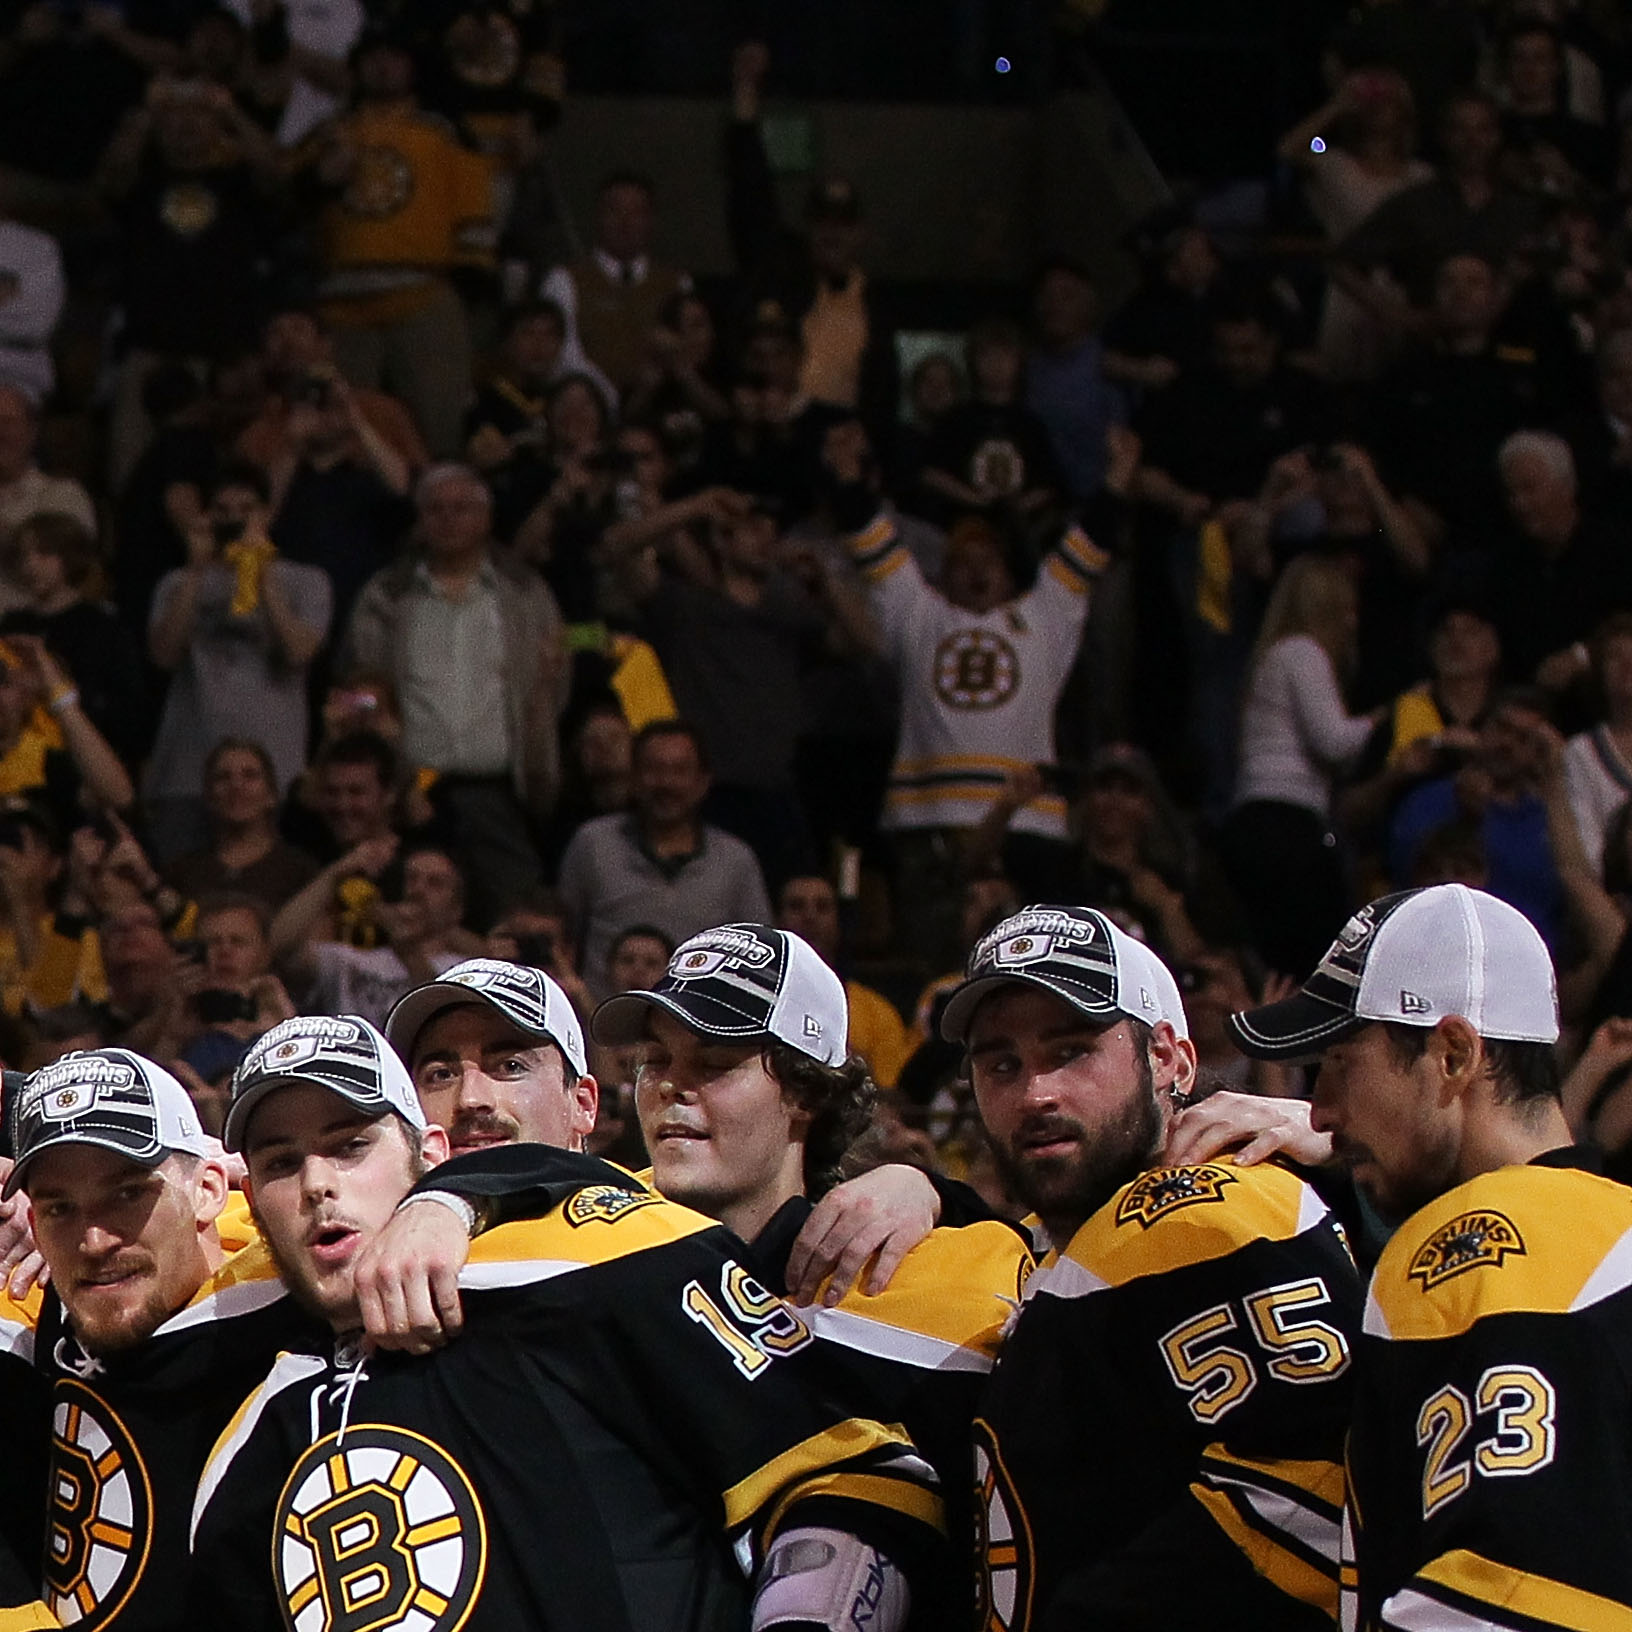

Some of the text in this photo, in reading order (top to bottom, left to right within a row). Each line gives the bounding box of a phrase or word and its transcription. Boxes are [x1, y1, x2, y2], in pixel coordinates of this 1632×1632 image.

[1123, 1167, 1220, 1213] BRUINS
[1419, 1216, 1512, 1267] BRUINS
[681, 1259, 814, 1380] 19
[1158, 1277, 1353, 1424] 55
[1416, 1364, 1556, 1520] 23
